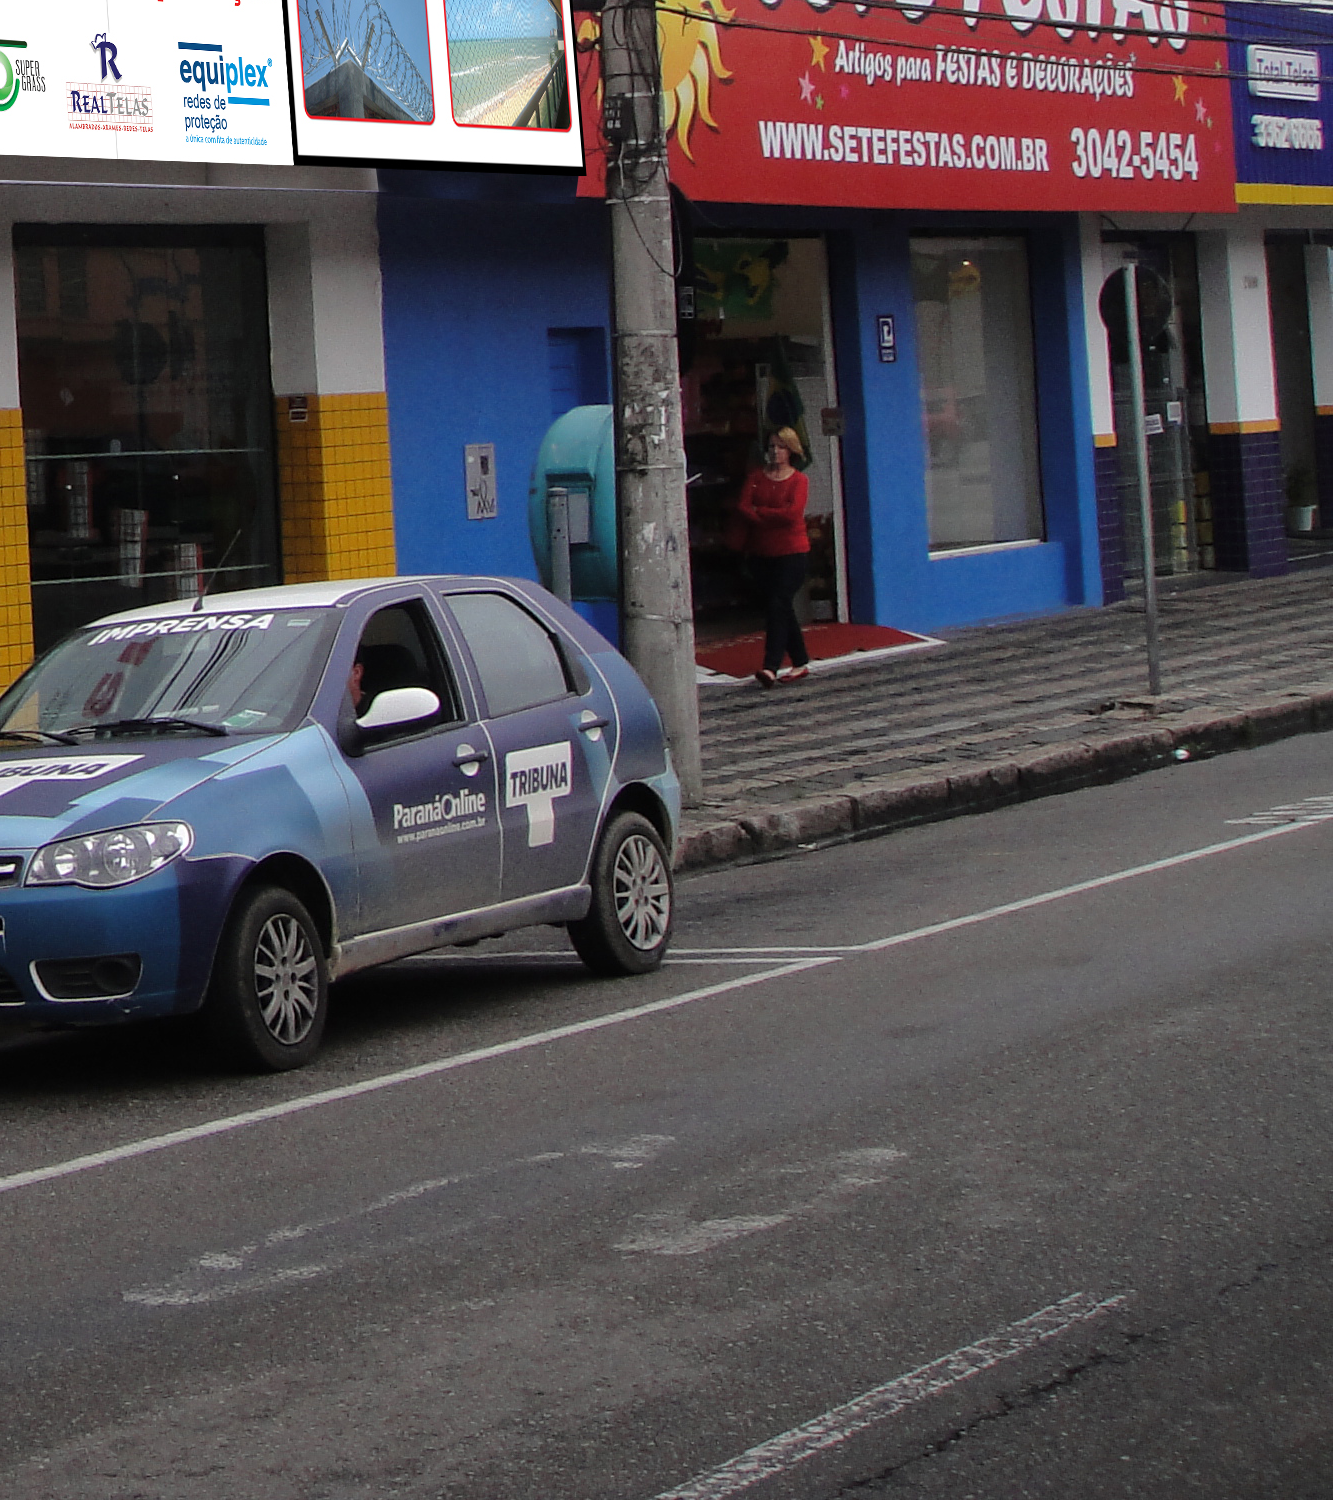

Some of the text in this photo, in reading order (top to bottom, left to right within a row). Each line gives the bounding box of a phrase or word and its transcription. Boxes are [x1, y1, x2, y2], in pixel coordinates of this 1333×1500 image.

[15, 59, 41, 77] SUPER
[834, 40, 893, 86] Artigos
[896, 57, 932, 86] para
[935, 44, 1002, 89] FESTAS
[21, 75, 47, 93] GRASS
[183, 94, 227, 110] redes de
[184, 113, 228, 133] proteção
[758, 120, 1050, 172] WWW.SETEFESTAS.COM.BR
[1070, 126, 1199, 182] 3042-5454
[86, 612, 275, 646] IMPRENSA
[509, 761, 569, 799] TRIBUNA
[393, 786, 486, 830] ParanáOnline
